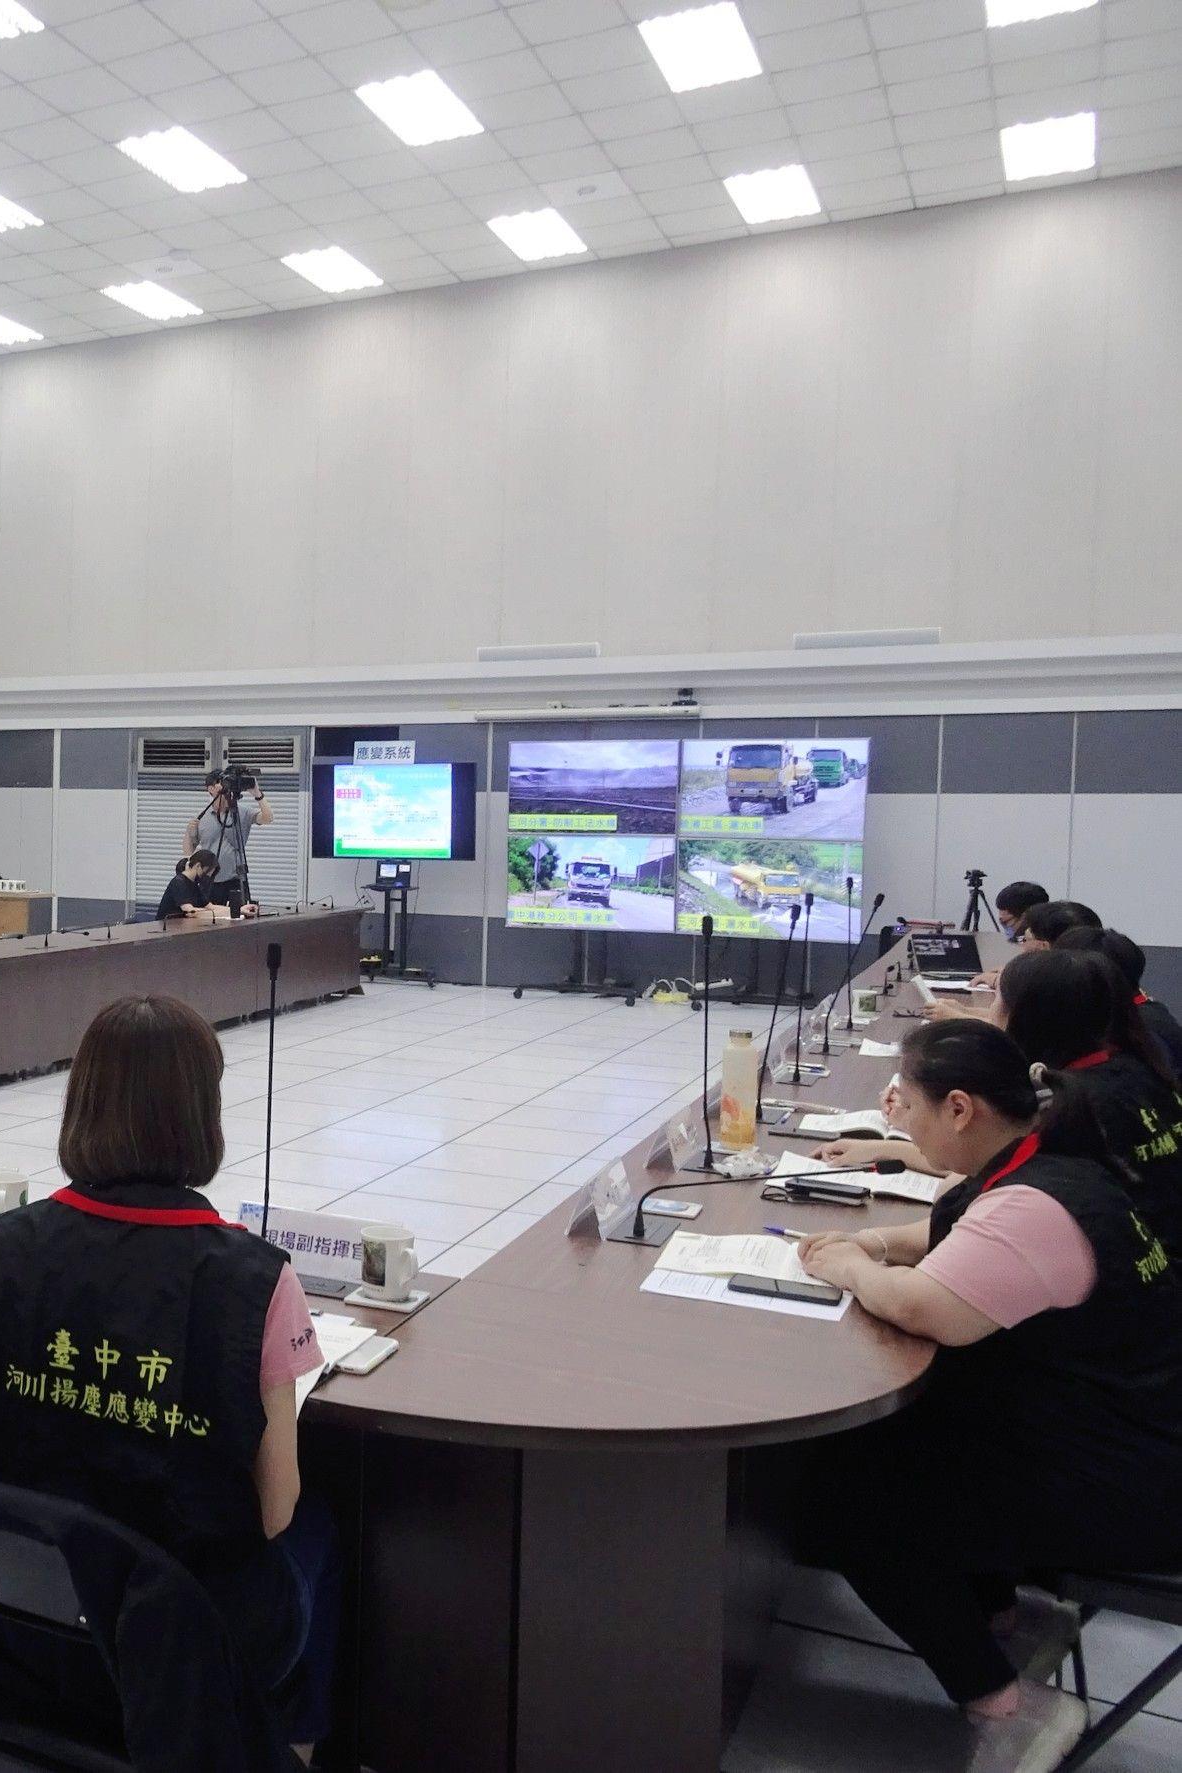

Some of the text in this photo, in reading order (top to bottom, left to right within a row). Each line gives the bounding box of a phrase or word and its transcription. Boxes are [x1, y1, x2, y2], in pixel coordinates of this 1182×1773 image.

[357, 746, 412, 760] 應變系統
[46, 1328, 173, 1392] 臺中市
[5, 1363, 211, 1438] 河川揚塵應變中心
